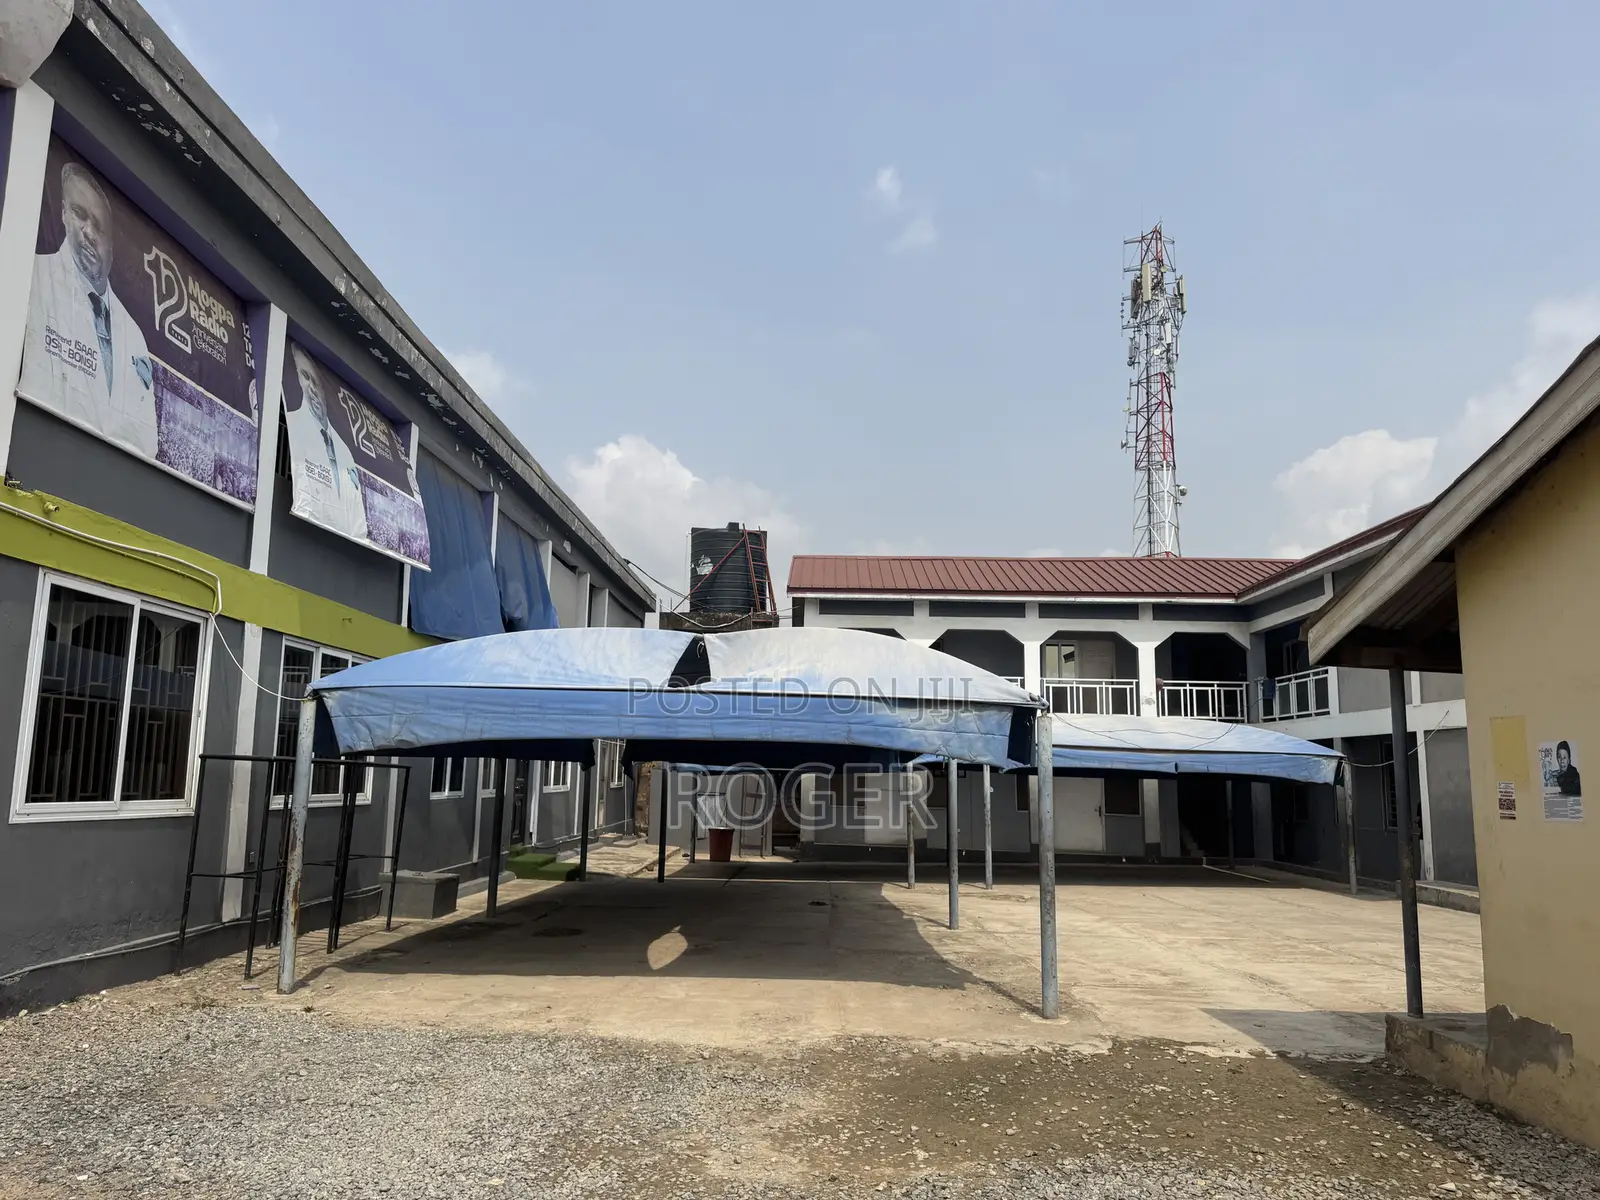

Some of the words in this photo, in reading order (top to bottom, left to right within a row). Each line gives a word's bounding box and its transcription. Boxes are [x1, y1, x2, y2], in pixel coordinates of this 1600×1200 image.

[188, 275, 236, 329] Mogpa
[189, 298, 229, 344] Radio
[45, 324, 72, 346] Reverend
[74, 339, 98, 361] ISAAC
